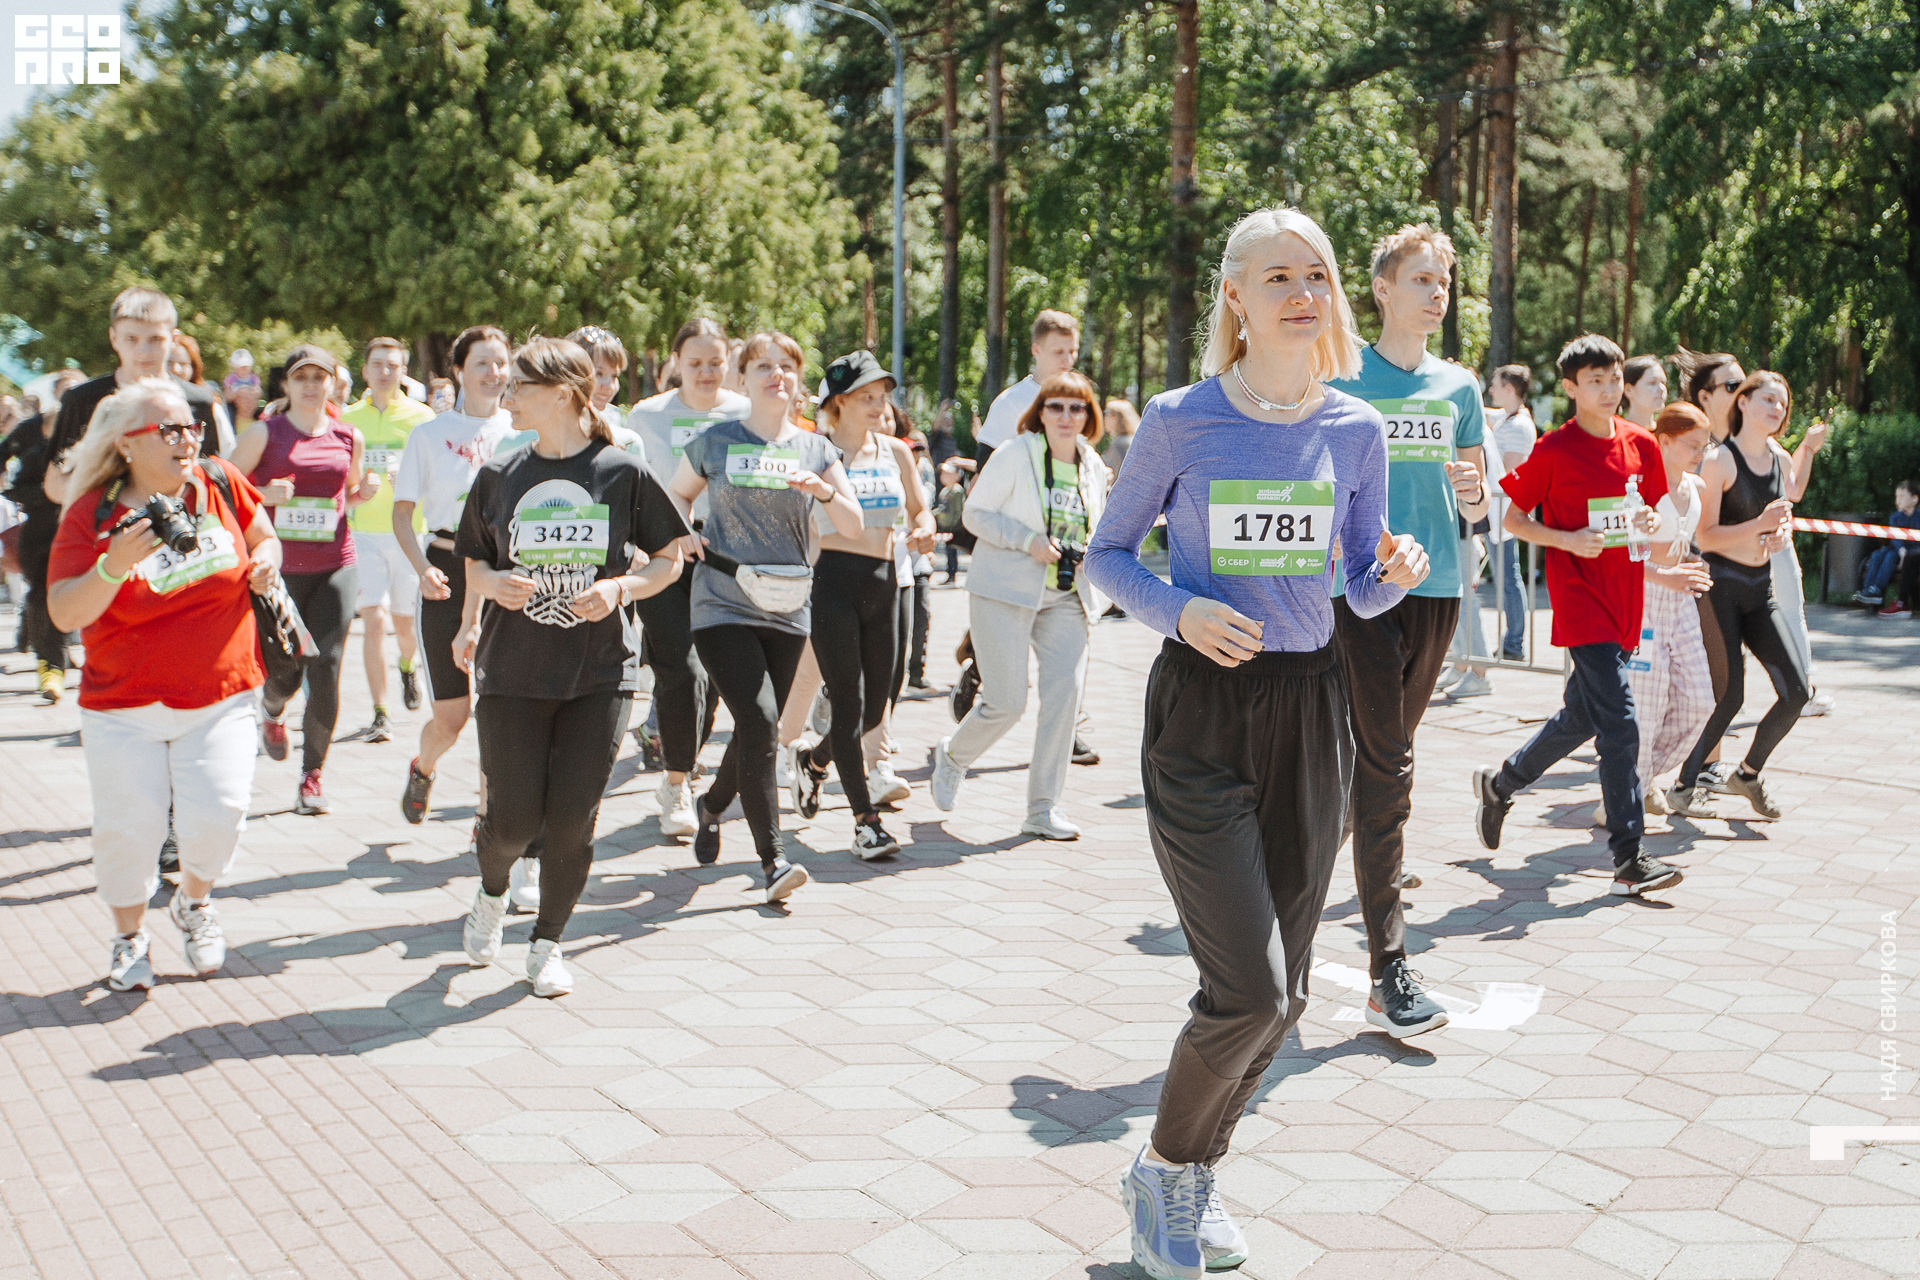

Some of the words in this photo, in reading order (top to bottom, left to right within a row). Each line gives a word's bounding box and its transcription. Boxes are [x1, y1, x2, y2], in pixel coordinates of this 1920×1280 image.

[1387, 420, 1442, 440] 2216
[738, 457, 787, 473] 3300
[534, 525, 594, 543] 3422
[1234, 513, 1315, 542] 1781
[1228, 558, 1250, 566] СБЕР
